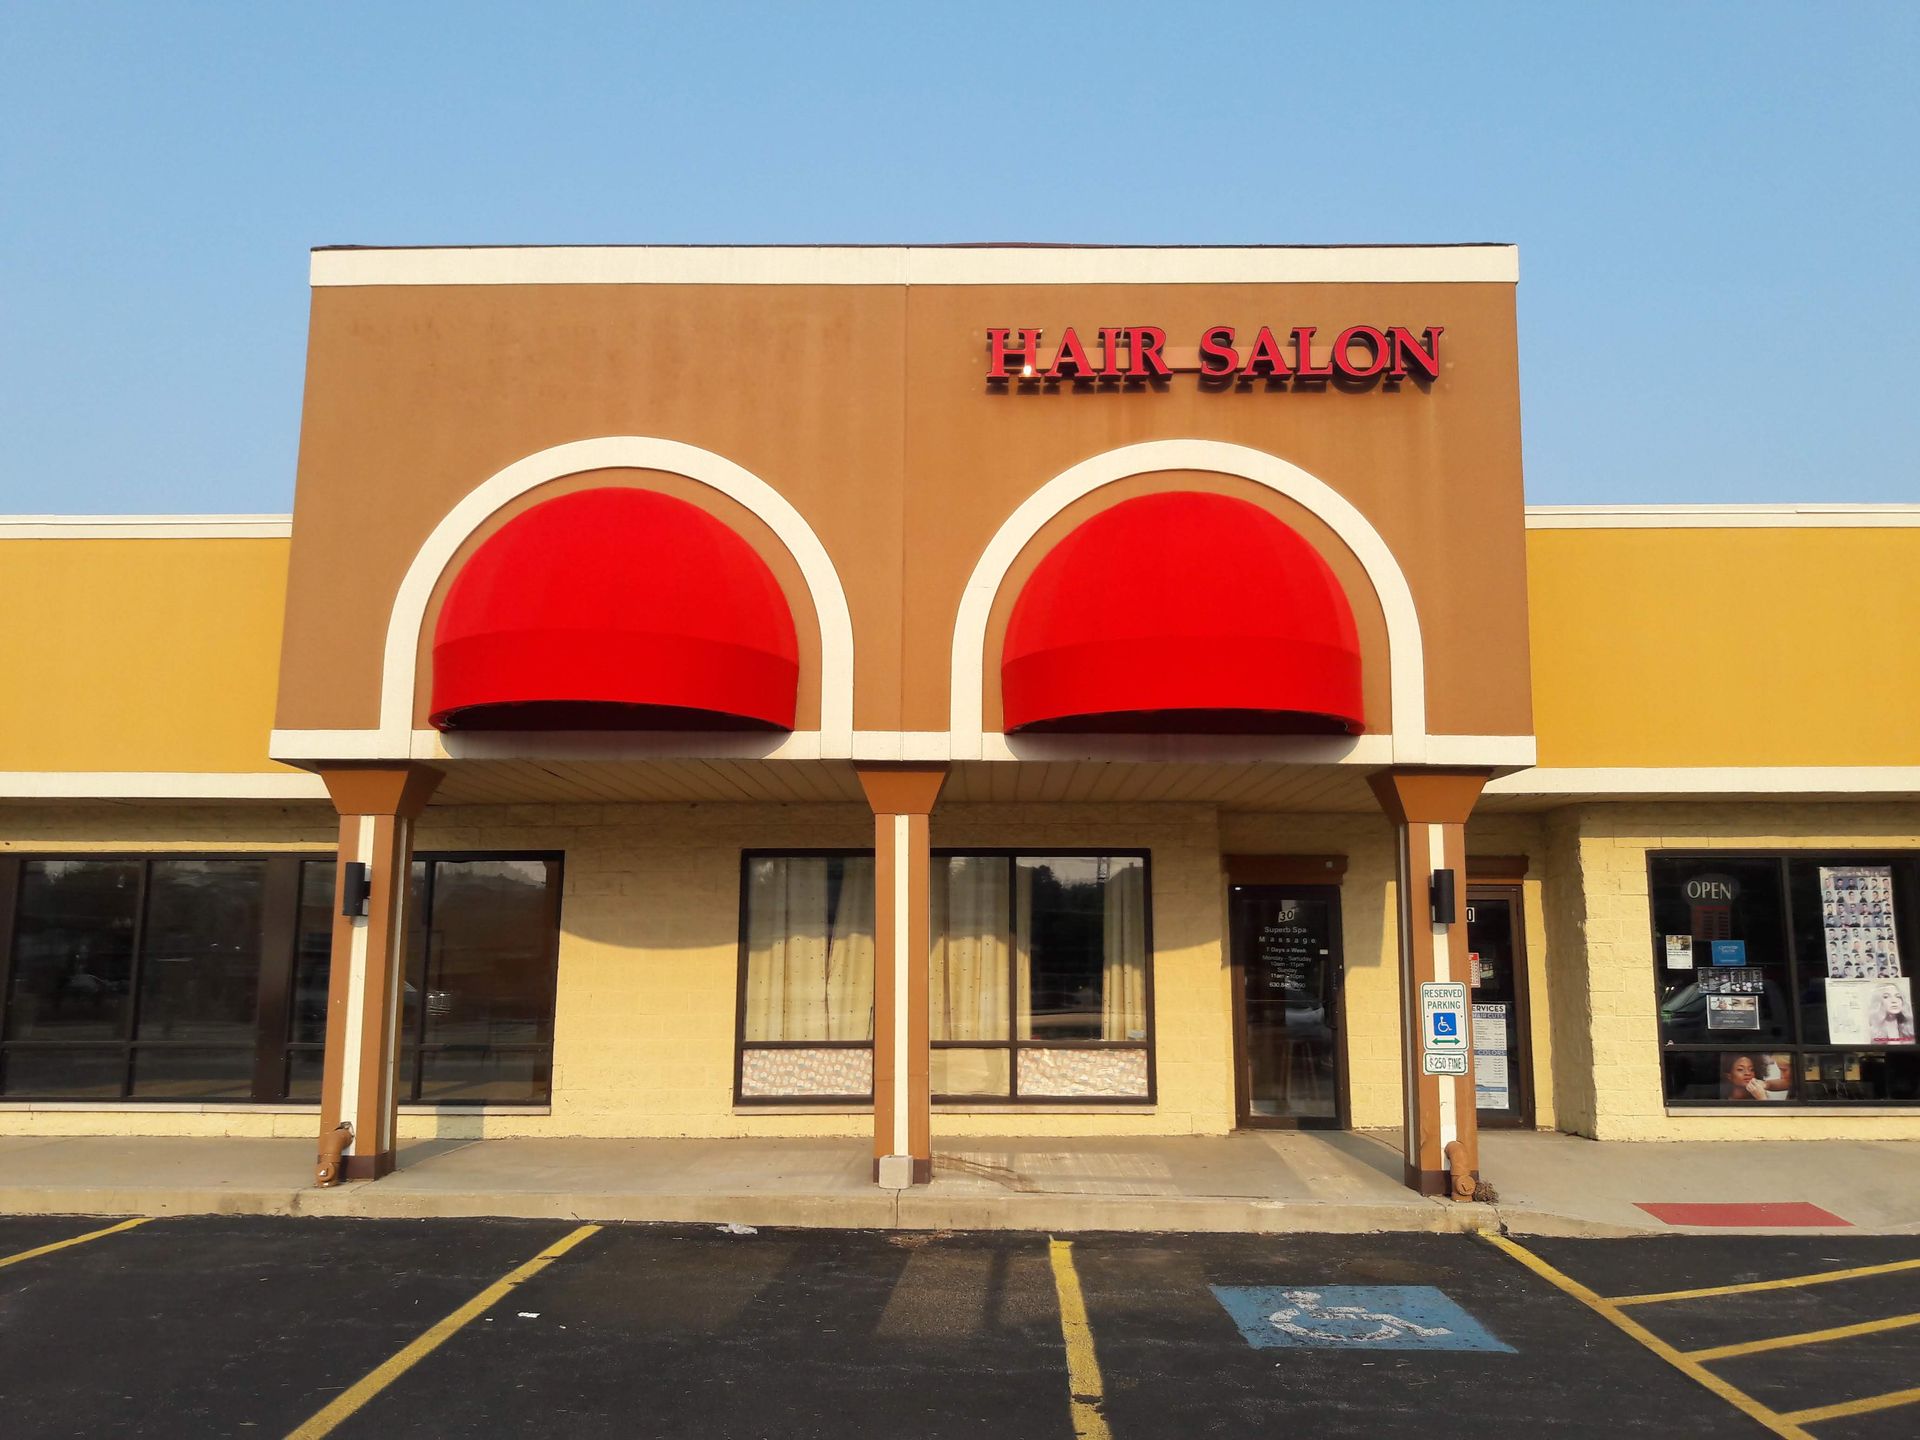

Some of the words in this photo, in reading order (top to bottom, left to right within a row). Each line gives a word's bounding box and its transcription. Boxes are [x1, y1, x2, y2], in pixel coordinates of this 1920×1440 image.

[986, 327, 1174, 383] HAIR
[1200, 326, 1445, 383] SALON
[1686, 880, 1732, 900] OPEN
[1280, 910, 1294, 921] 30
[1264, 926, 1291, 934] Superb
[1292, 926, 1307, 934] Spa
[1258, 936, 1316, 944] Massage
[1424, 989, 1463, 998] RESERVED
[1427, 1000, 1461, 1009] PARKING
[1448, 1057, 1462, 1070] FINE
